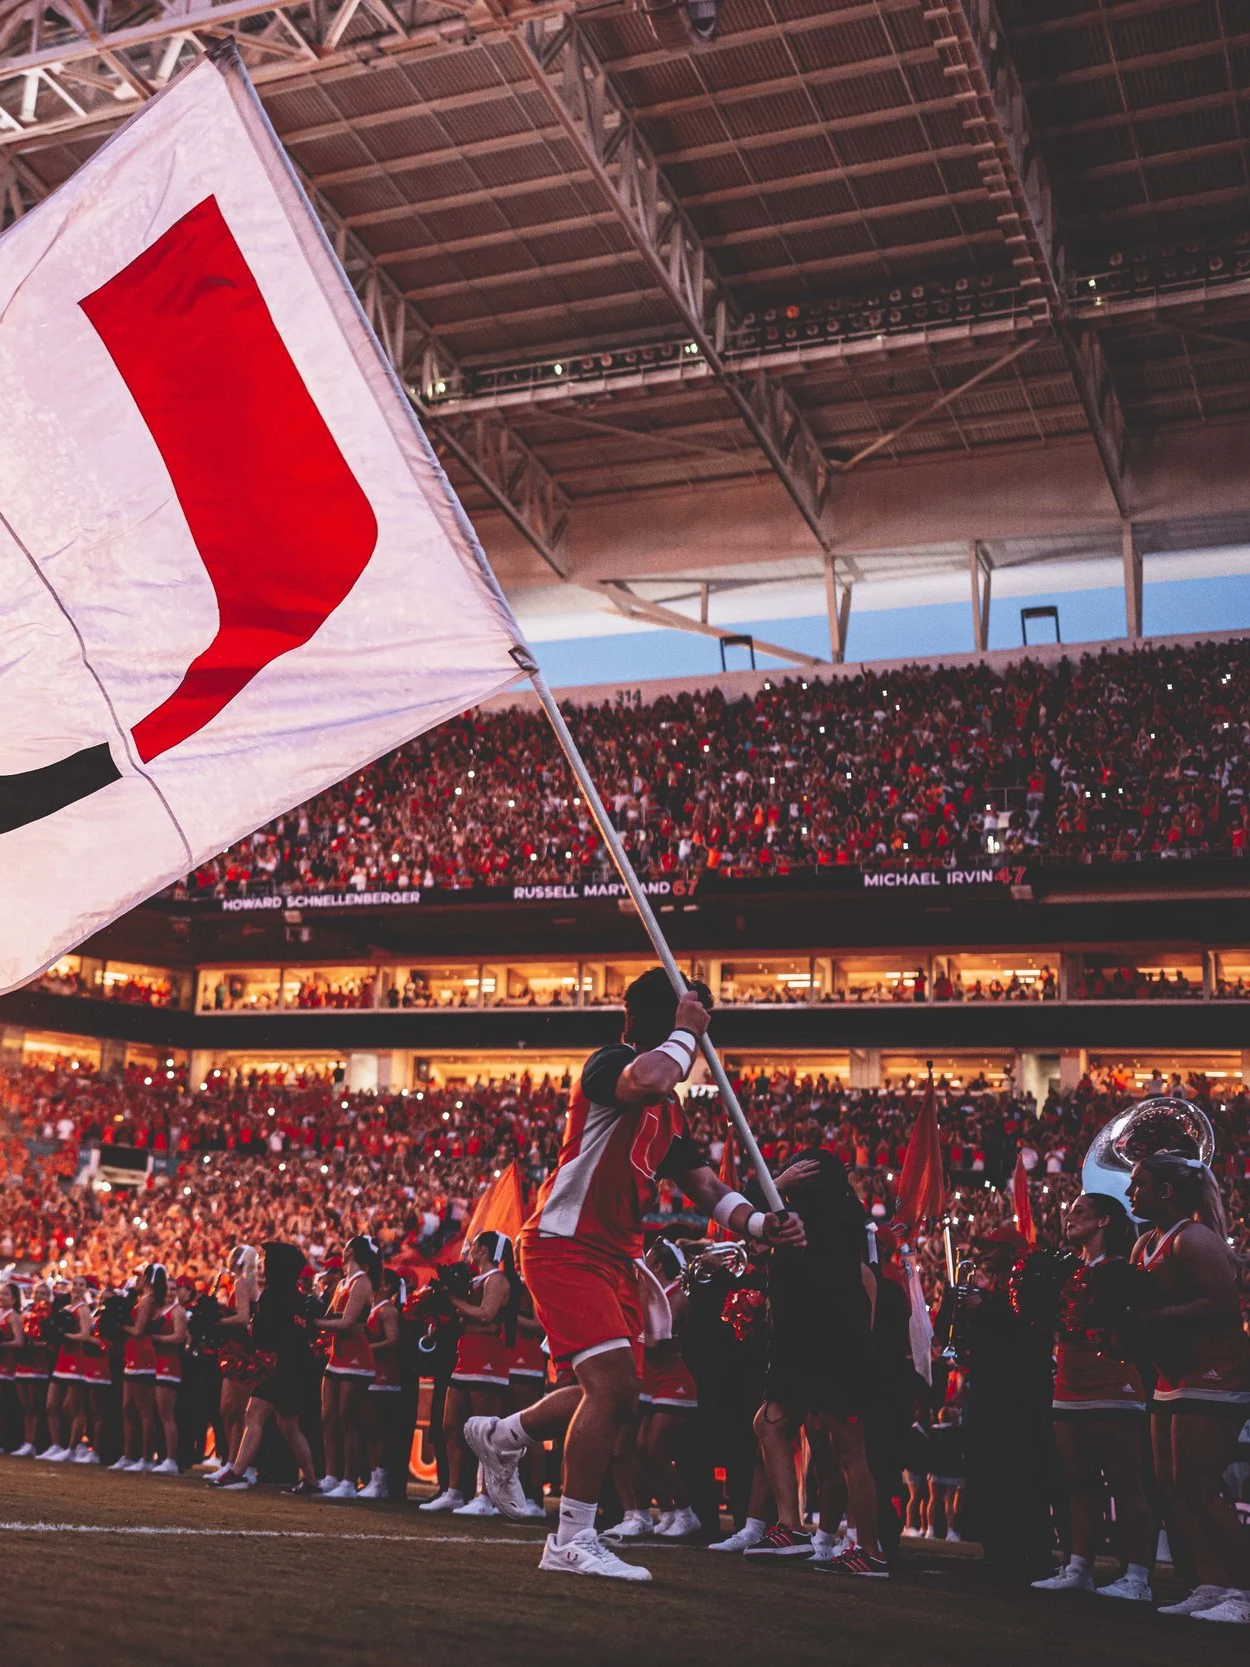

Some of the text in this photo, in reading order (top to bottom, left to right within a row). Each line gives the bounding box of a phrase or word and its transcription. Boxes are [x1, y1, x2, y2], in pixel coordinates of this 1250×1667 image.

[863, 865, 1027, 887] MICHAEL IRVIN 47
[513, 879, 699, 900] RUSSELL MARYAND 67
[222, 891, 420, 912] HOWARD SCHNELLENBERGER
